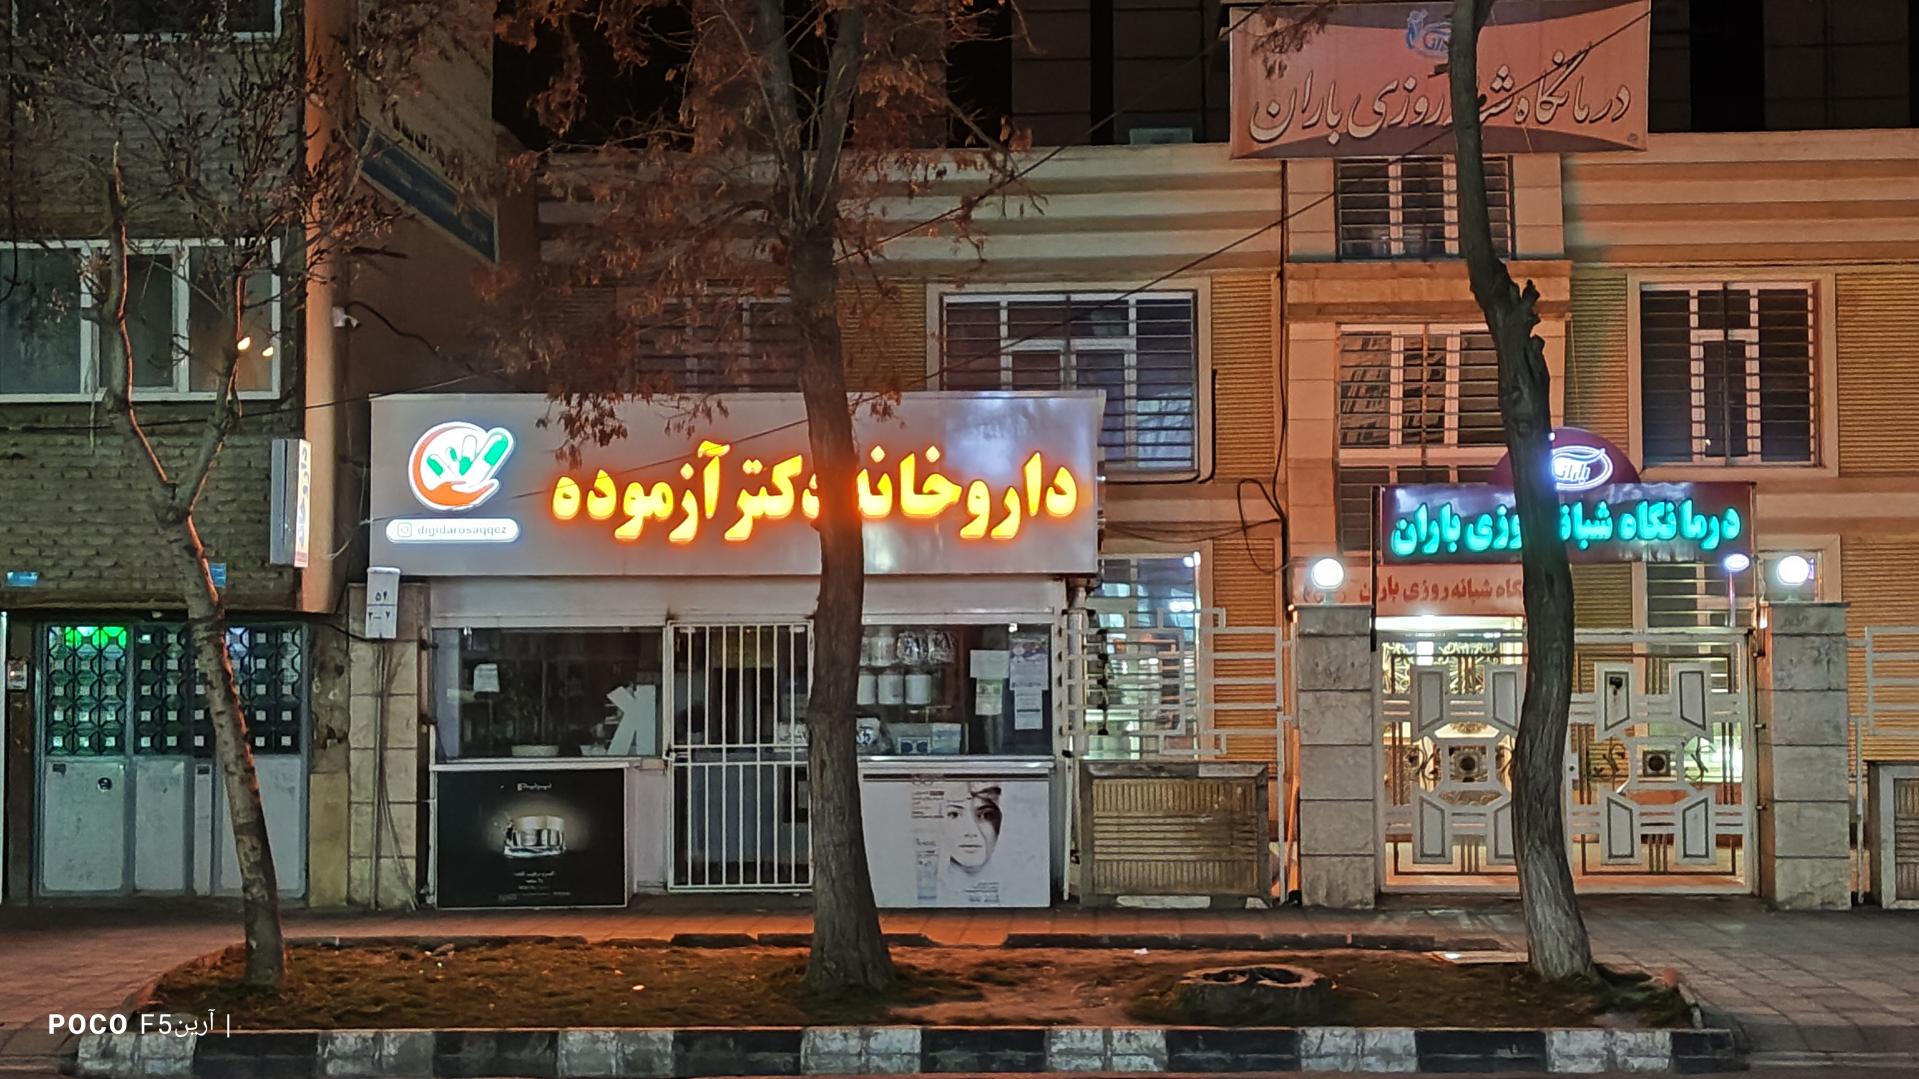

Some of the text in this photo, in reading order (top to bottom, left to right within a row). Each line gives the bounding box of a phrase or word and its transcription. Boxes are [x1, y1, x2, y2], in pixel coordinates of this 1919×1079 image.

[1249, 70, 1342, 146] باران
[1347, 75, 1444, 139] روزی
[1515, 41, 1631, 124] درمانگاه
[551, 439, 731, 543] آزموده
[856, 444, 1078, 541] داروخان
[1390, 502, 1462, 556] باران
[1560, 500, 1613, 550] شبان
[1619, 499, 1741, 550] درمانگاه
[1403, 578, 1449, 602] روزی
[1451, 576, 1493, 604] شبانه
